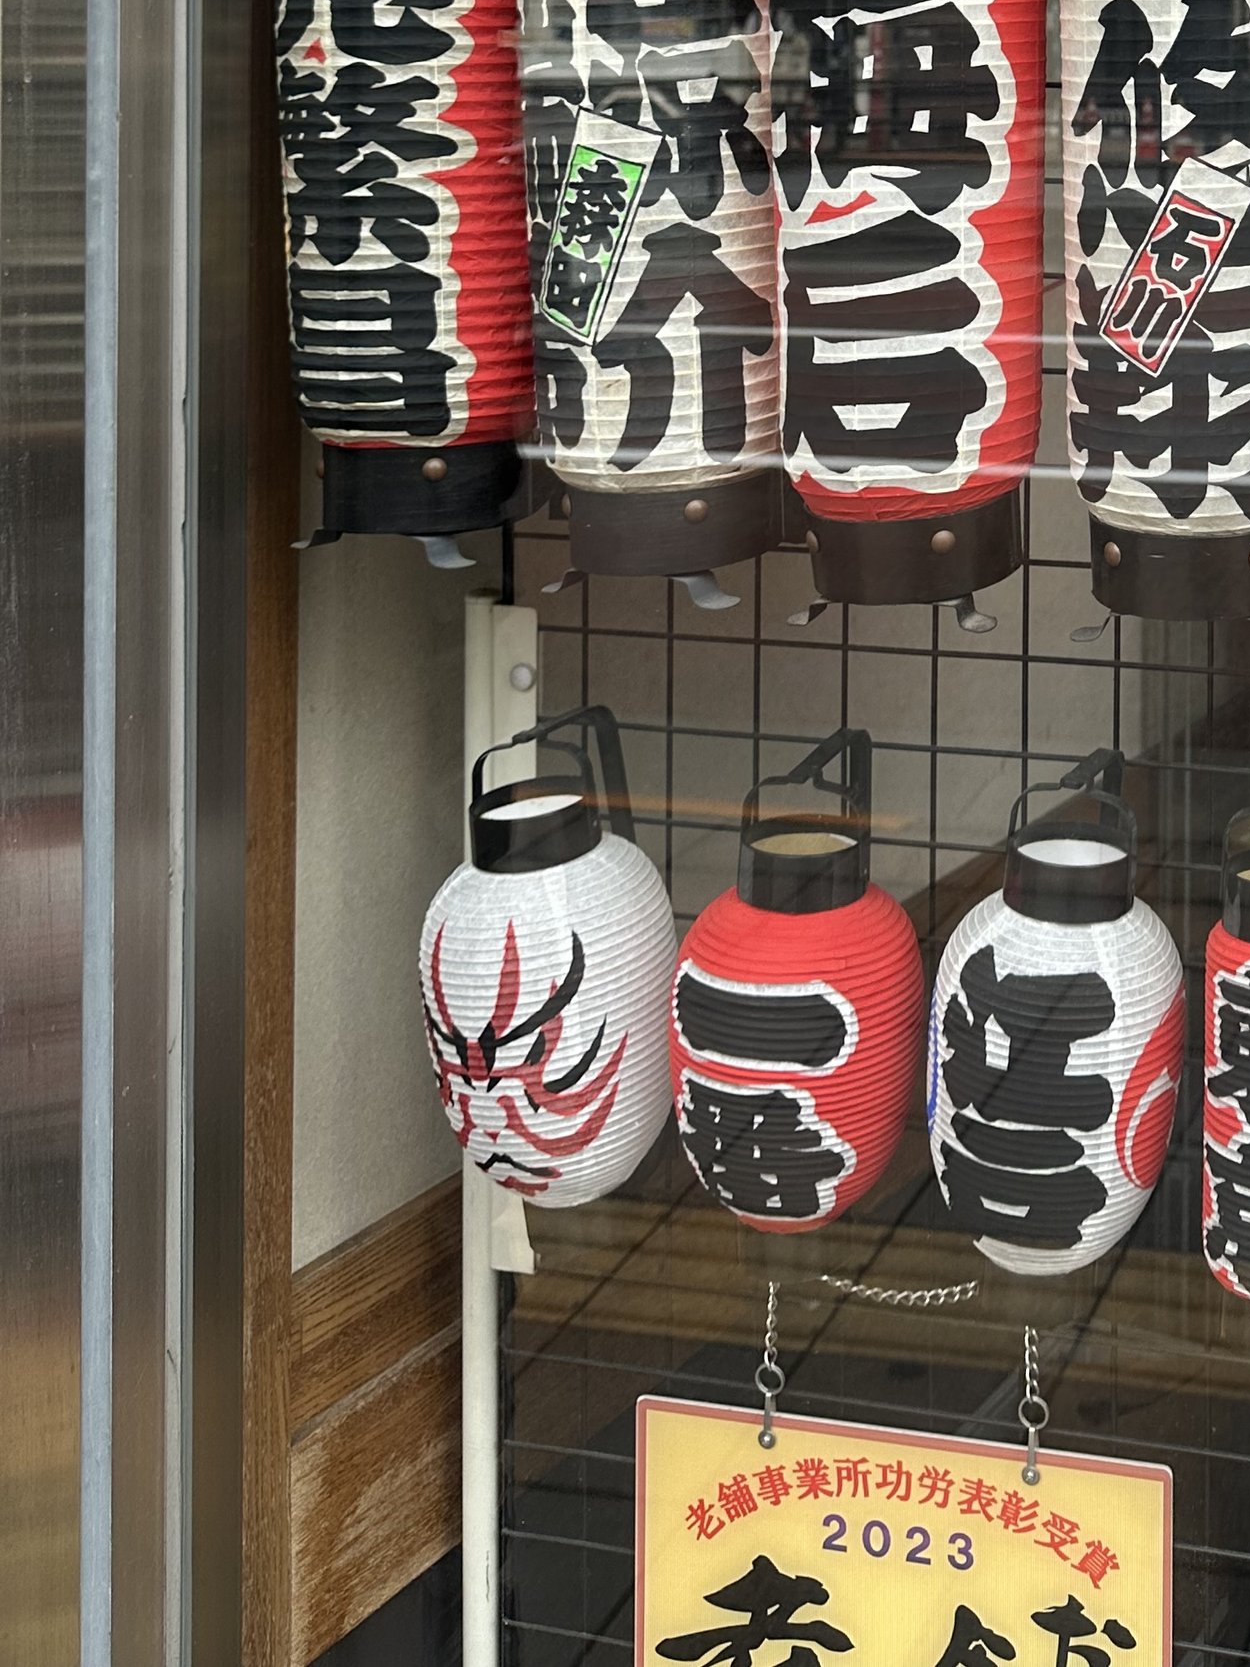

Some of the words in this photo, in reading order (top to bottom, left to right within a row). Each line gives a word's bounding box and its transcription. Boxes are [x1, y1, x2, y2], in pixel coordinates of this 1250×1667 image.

[1112, 207, 1220, 360] 石川
[685, 1457, 1120, 1590] 老舗事業所功労表彰受賞
[822, 1513, 975, 1571] 2023
